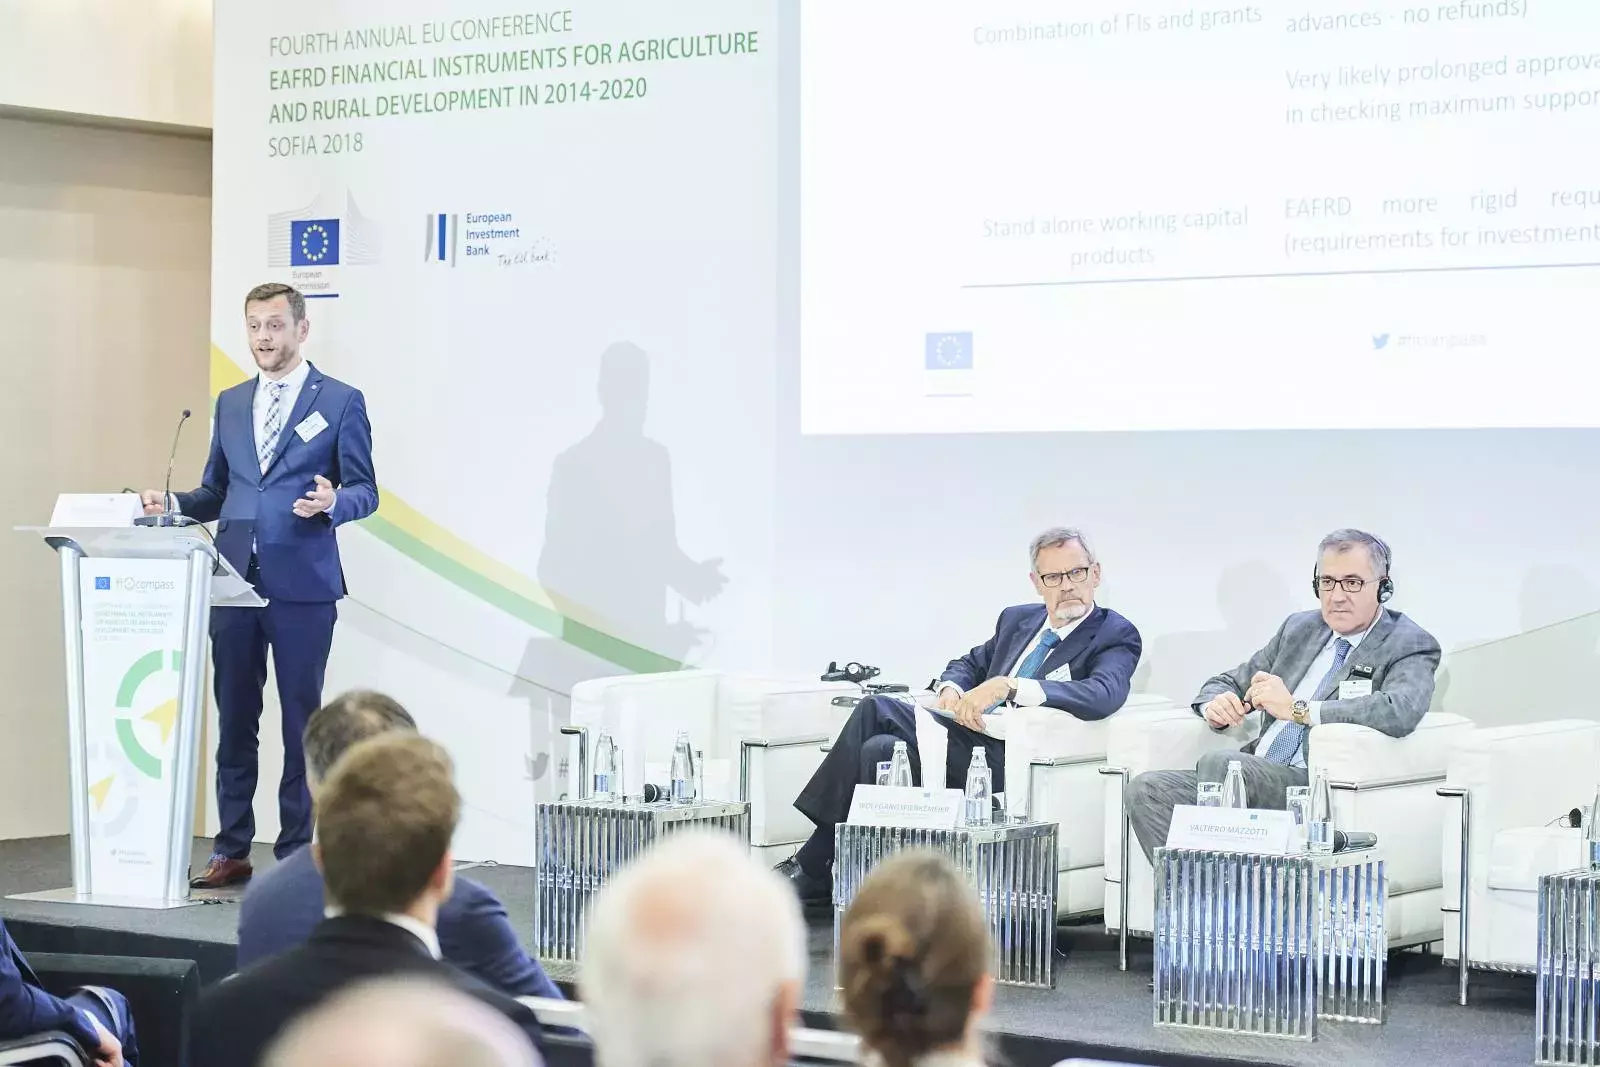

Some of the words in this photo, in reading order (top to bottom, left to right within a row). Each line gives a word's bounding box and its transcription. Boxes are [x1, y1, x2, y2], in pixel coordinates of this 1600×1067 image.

[973, 20, 1094, 45] Combination
[1099, 13, 1119, 35] of
[1126, 13, 1151, 33] FIs
[1157, 9, 1195, 29] and
[1200, 6, 1263, 31] grants
[1286, 10, 1382, 33] advances
[1403, 8, 1430, 24] no
[1437, 0, 1528, 21] refunds)
[270, 29, 338, 57] FOURTH
[343, 24, 417, 51] ANNUAL
[422, 21, 445, 44] EU
[450, 10, 573, 41] CONFERENCE
[269, 66, 326, 90] EAFRD
[331, 58, 428, 86] FINANCIAL
[433, 46, 567, 77] INSTRUMENTS
[573, 43, 612, 67] FOR
[618, 31, 759, 63] AGRICULTURE
[1285, 68, 1331, 91] Very
[1337, 63, 1391, 88] likely
[1398, 54, 1508, 86] prolonged
[269, 101, 307, 124] AND
[313, 97, 371, 121] RURAL
[376, 87, 515, 117] DEVELOPMENT
[519, 84, 539, 107] IN
[544, 77, 648, 105] 2014-2020
[1286, 103, 1303, 124] in
[1310, 97, 1402, 123] checking
[1409, 94, 1515, 116] maximum
[268, 134, 318, 157] SOFIA
[322, 132, 364, 154] 2018
[466, 212, 513, 226] European
[1285, 196, 1352, 220] EAFRD
[1382, 196, 1439, 214] more
[1470, 187, 1518, 214] rigid
[466, 228, 520, 240] Investment
[982, 214, 1035, 238] Stand
[1041, 213, 1095, 234] alone
[1099, 210, 1178, 234] working
[1183, 204, 1250, 230] capital
[466, 244, 490, 256] Bank
[1284, 229, 1434, 258] (requirements
[1441, 226, 1472, 247] for
[1478, 224, 1600, 245] investment
[1071, 245, 1156, 272] products
[1190, 824, 1226, 834] VALTIERO
[1227, 826, 1269, 837] MAZZOTTI
